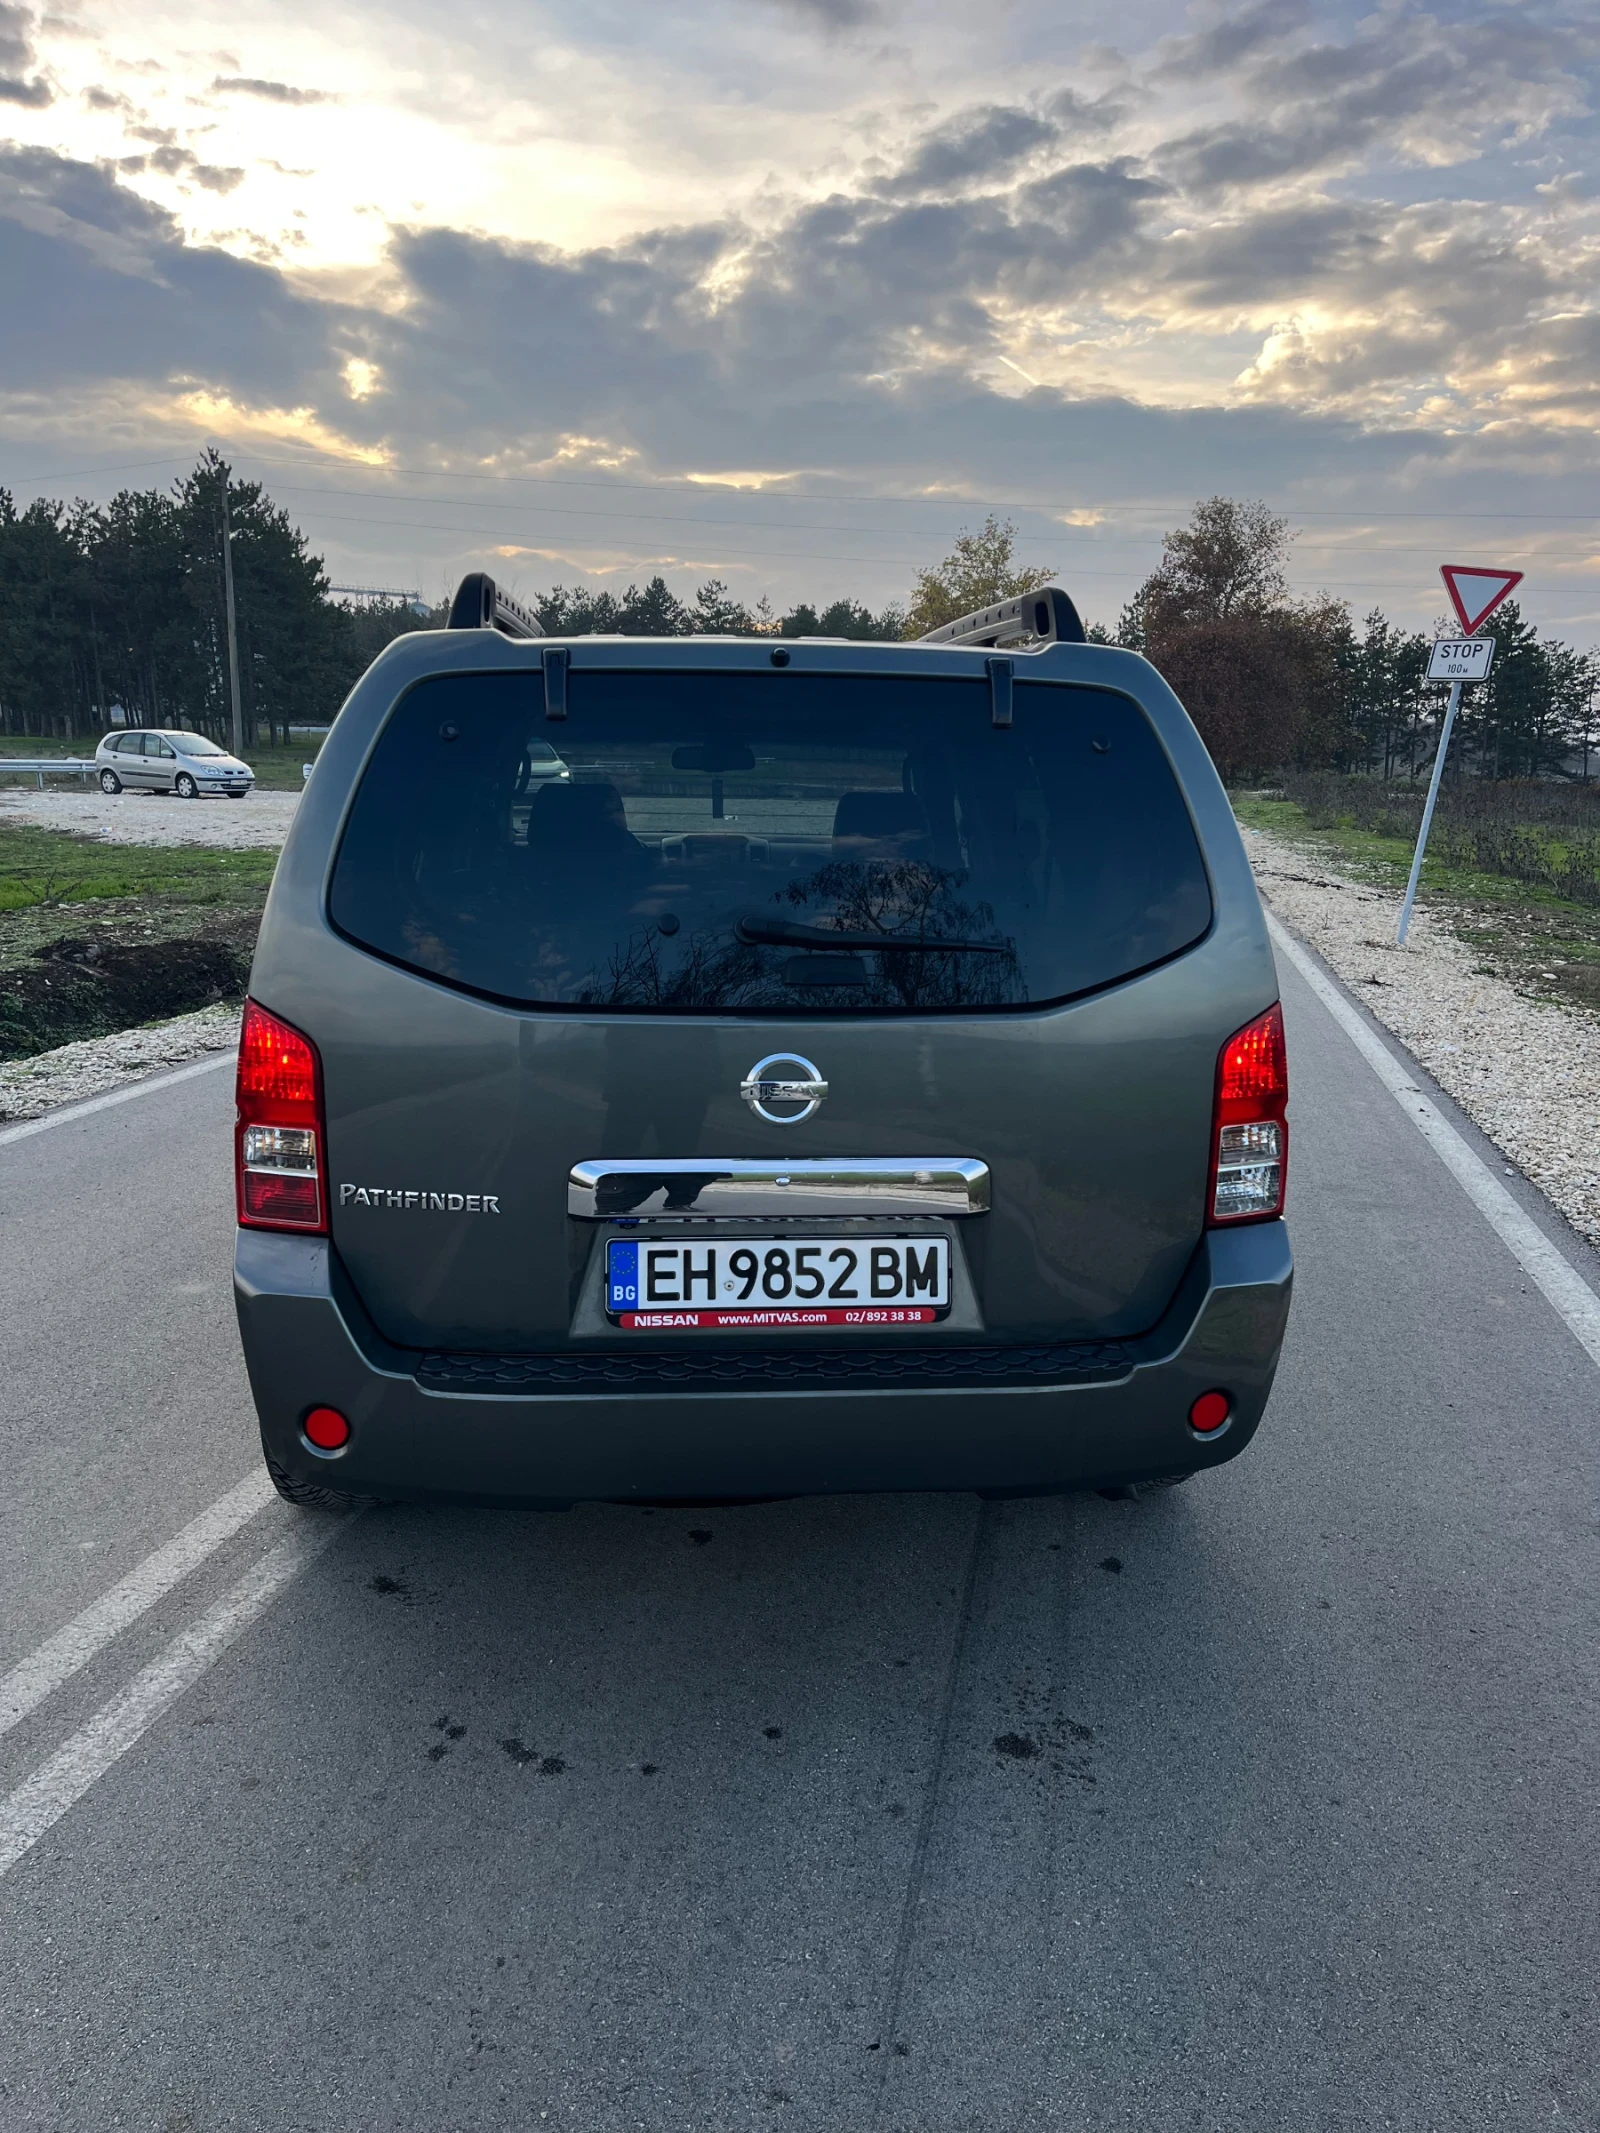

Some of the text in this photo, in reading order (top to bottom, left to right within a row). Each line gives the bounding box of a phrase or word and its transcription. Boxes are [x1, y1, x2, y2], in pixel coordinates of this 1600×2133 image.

[1440, 644, 1483, 658] STOP
[339, 1183, 501, 1213] PATHFINDER
[647, 1246, 939, 1302] EH 9852 BM
[613, 1285, 636, 1301] BG
[634, 1310, 922, 1327] NISSAN www.MITVAS.com 02/892 38 38
